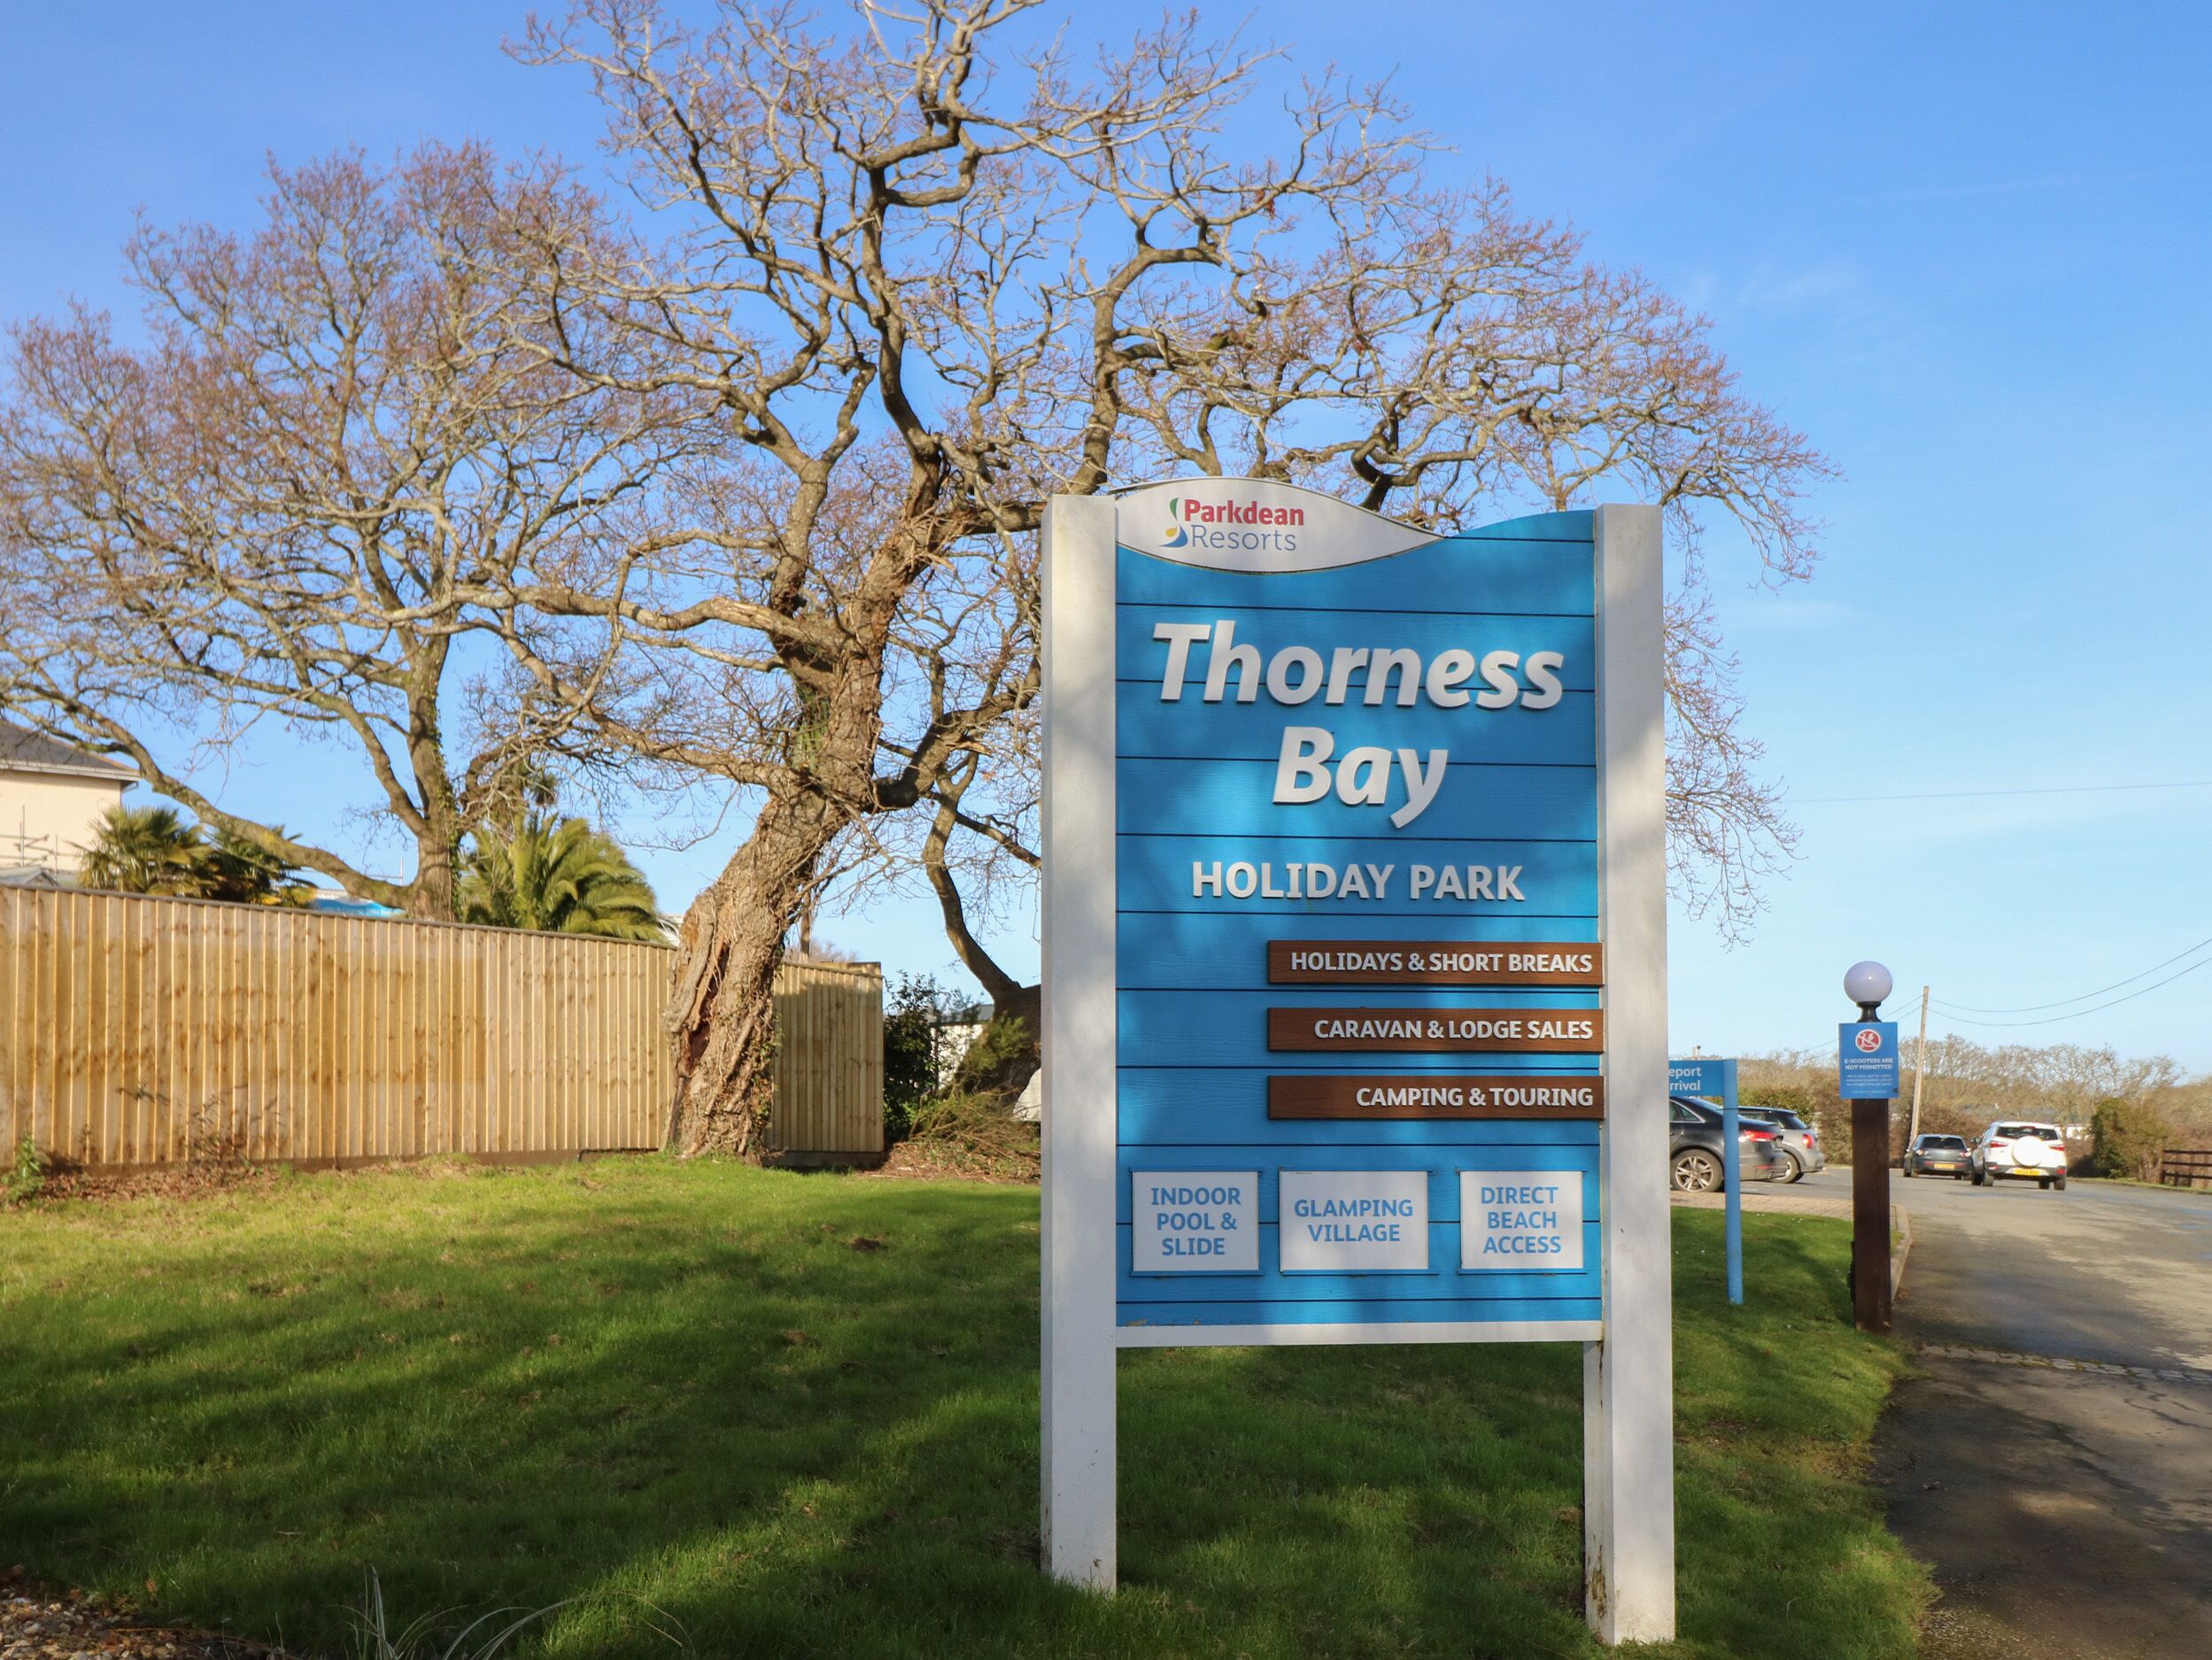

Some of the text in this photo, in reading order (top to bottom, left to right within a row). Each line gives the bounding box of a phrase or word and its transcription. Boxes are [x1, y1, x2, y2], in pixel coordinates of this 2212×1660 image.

[1184, 498, 1304, 526] Parkdean
[1191, 524, 1296, 552] Resorts
[1152, 619, 1565, 710] Thorness
[1272, 725, 1449, 830] Bay
[1191, 861, 1526, 901] HOLIDAY PARK
[1290, 951, 1593, 973] HOLIDAYS & SHORT BREAKS
[1313, 1019, 1594, 1040] CARAVAN & LODGE SALES
[1668, 1066, 1702, 1080] eport
[1669, 1079, 1700, 1092] rrival
[1356, 1087, 1594, 1108] CAMPING & TOURING
[1151, 1187, 1241, 1206] INDOOR
[1481, 1186, 1558, 1205] DIRECT
[1294, 1199, 1413, 1218] GLAMPING
[1156, 1212, 1238, 1231] POOL &
[1487, 1211, 1558, 1230] BEACH
[1308, 1224, 1401, 1242] VILLAGE
[1162, 1238, 1226, 1256] SLIDE
[1482, 1236, 1562, 1255] ACCESS
